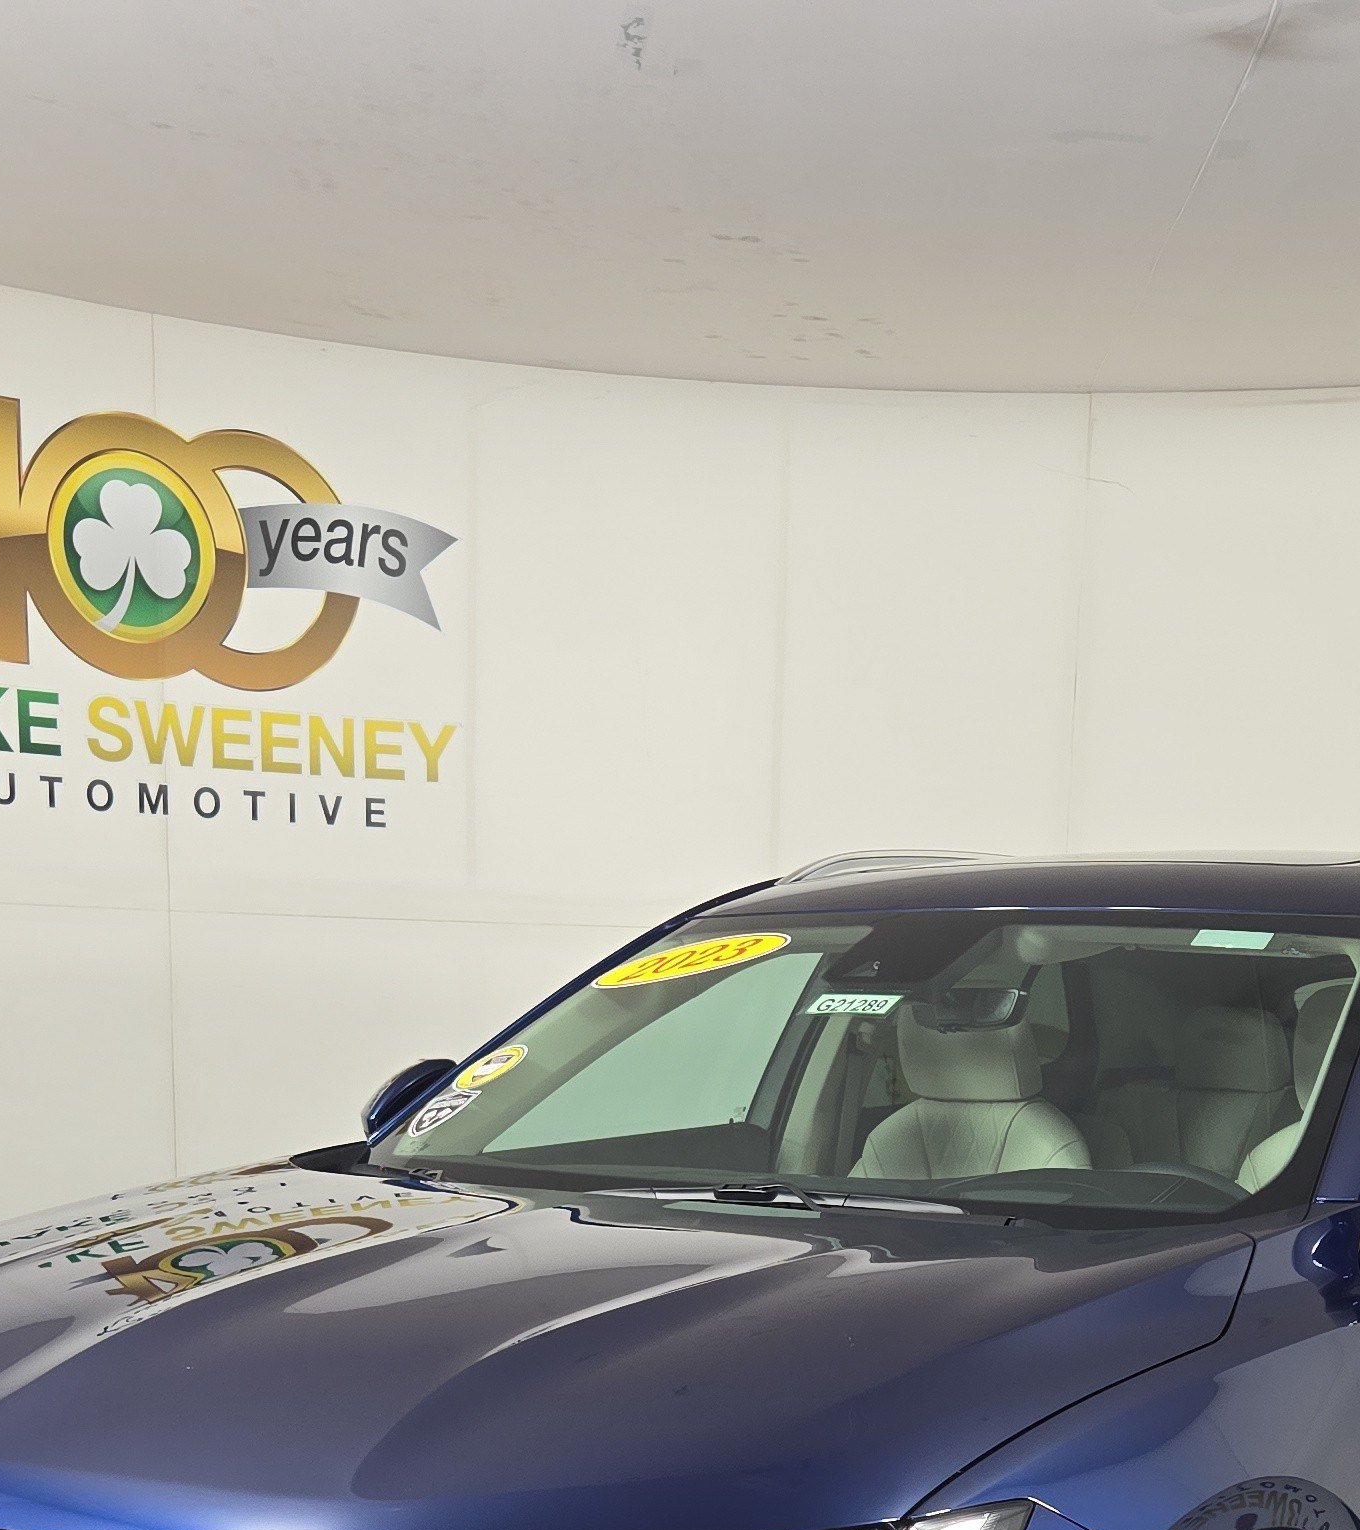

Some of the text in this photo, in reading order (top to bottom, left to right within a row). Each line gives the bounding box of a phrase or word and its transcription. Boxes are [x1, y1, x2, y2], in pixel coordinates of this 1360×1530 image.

[258, 516, 409, 577] years
[86, 696, 457, 783] SWEENEY
[617, 938, 763, 982] 2023
[817, 998, 889, 1012] G21289
